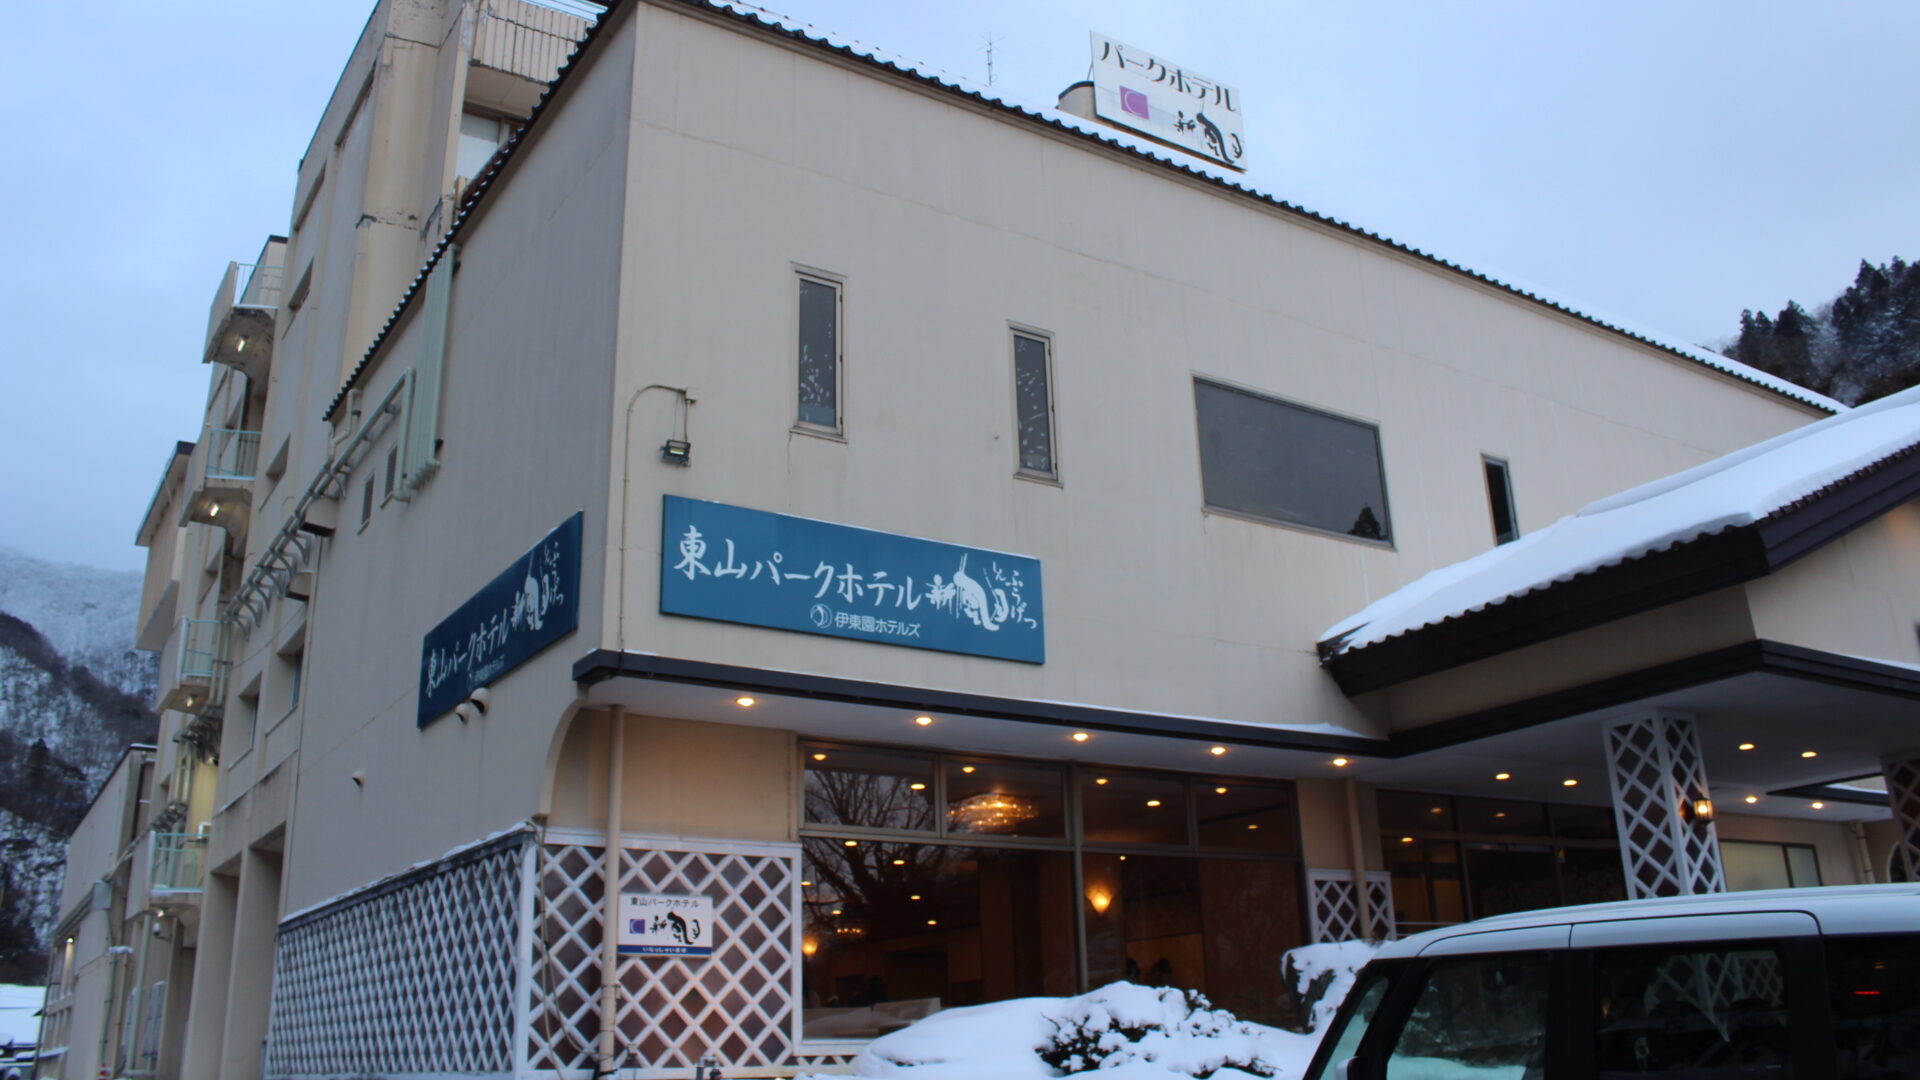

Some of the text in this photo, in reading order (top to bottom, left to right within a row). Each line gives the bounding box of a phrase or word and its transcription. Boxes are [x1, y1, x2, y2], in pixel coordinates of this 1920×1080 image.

[1101, 41, 1236, 112] パークホテル
[674, 525, 921, 611] 東山パークホテル
[425, 608, 509, 698] 東山パークホテル
[834, 611, 921, 638] 伊東園ホテルズ
[630, 896, 699, 908] 東山パークホテル
